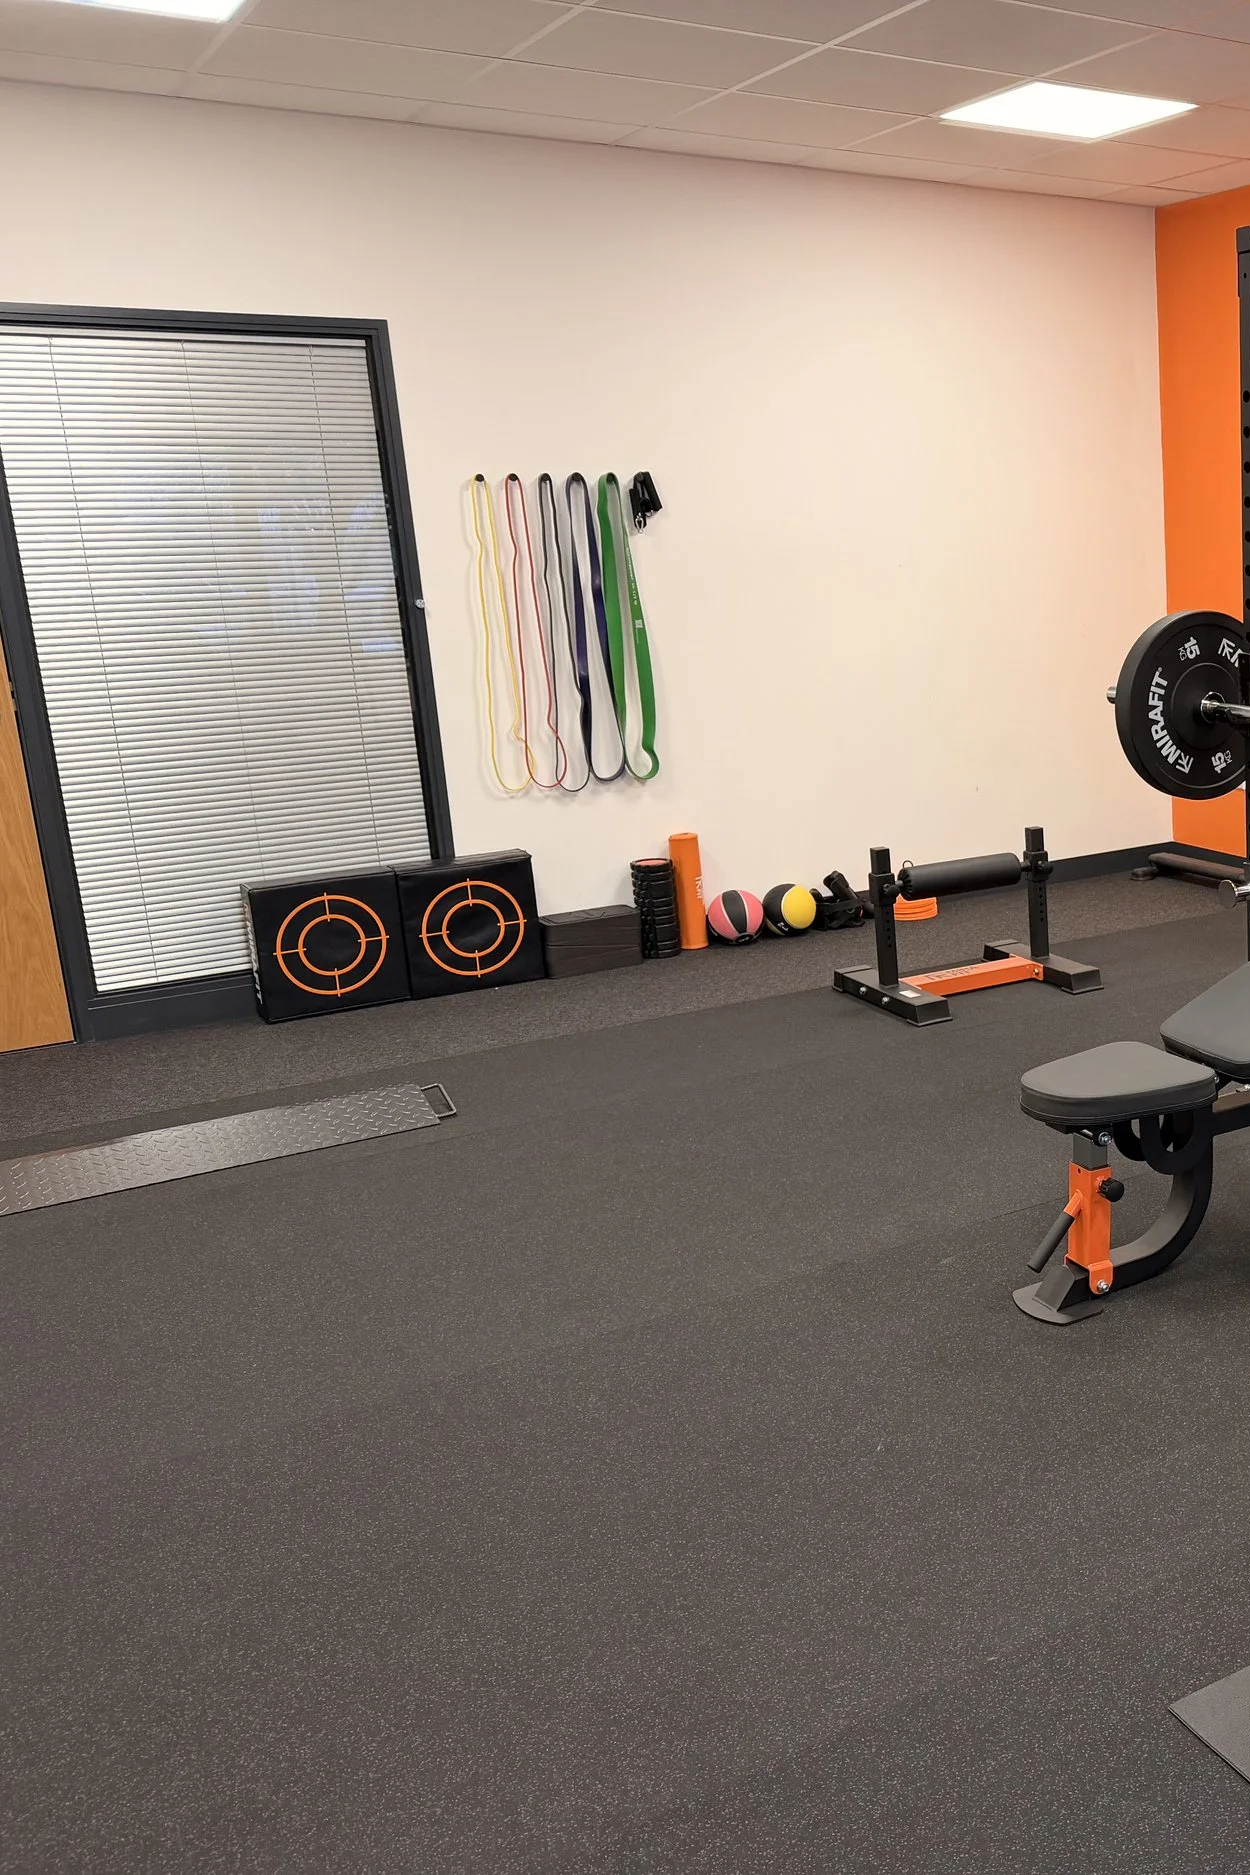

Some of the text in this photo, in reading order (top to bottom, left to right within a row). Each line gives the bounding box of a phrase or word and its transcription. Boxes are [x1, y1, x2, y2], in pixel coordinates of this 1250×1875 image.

[1184, 636, 1200, 660] 15
[1148, 670, 1181, 764] MIRAFIT
[1212, 752, 1226, 774] 15
